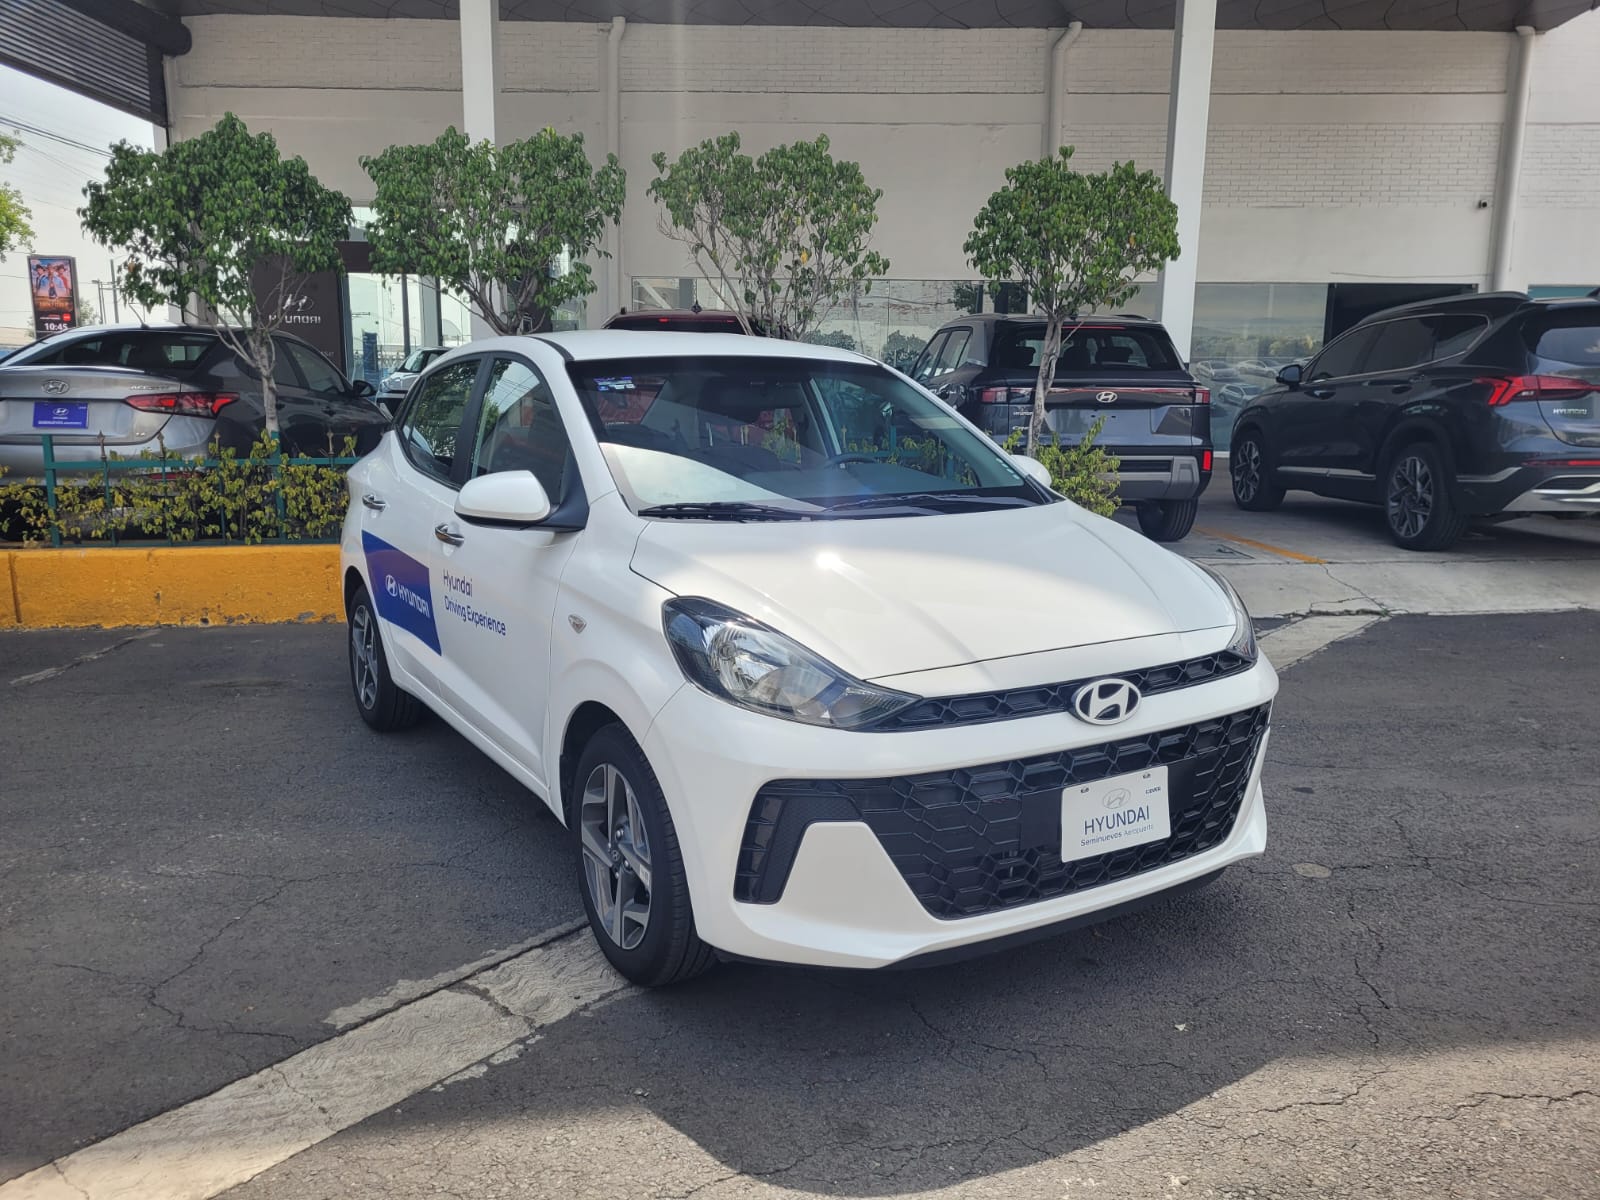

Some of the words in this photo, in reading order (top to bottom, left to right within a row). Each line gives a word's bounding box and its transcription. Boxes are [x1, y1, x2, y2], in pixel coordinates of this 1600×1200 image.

[44, 322, 68, 331] 10:45
[443, 569, 473, 598] Hyundai
[398, 582, 431, 619] HYUNDAI
[443, 595, 466, 622] Driving
[466, 605, 507, 636] Experience
[1084, 804, 1150, 836] HYUNDAI
[1080, 832, 1123, 847] Seminuevos
